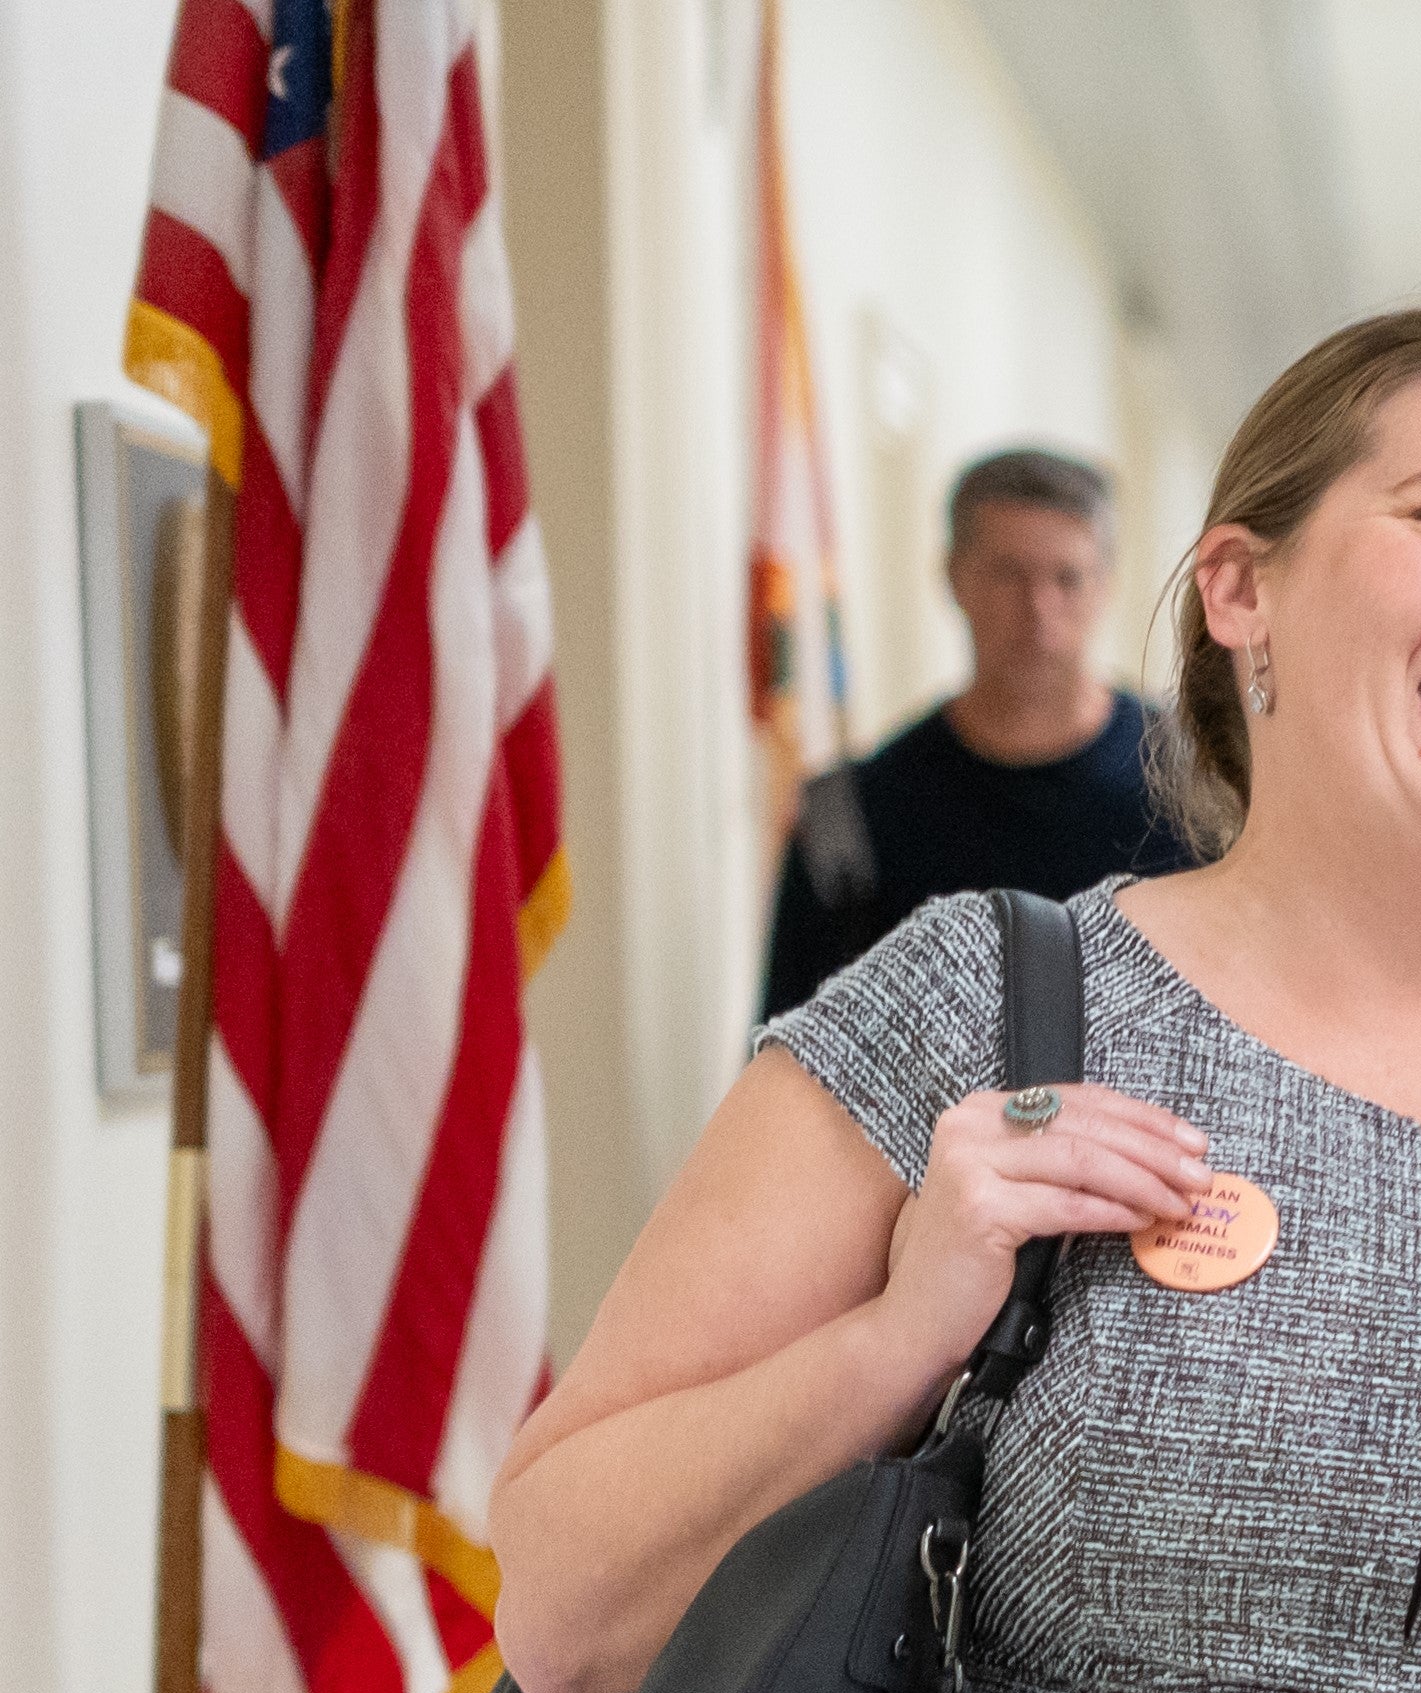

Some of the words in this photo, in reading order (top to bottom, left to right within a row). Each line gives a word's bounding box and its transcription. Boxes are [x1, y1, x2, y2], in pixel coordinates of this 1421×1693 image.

[1215, 1188, 1241, 1203] AN
[1176, 1220, 1228, 1239] SMALL
[1155, 1234, 1238, 1260] BUSINESS
